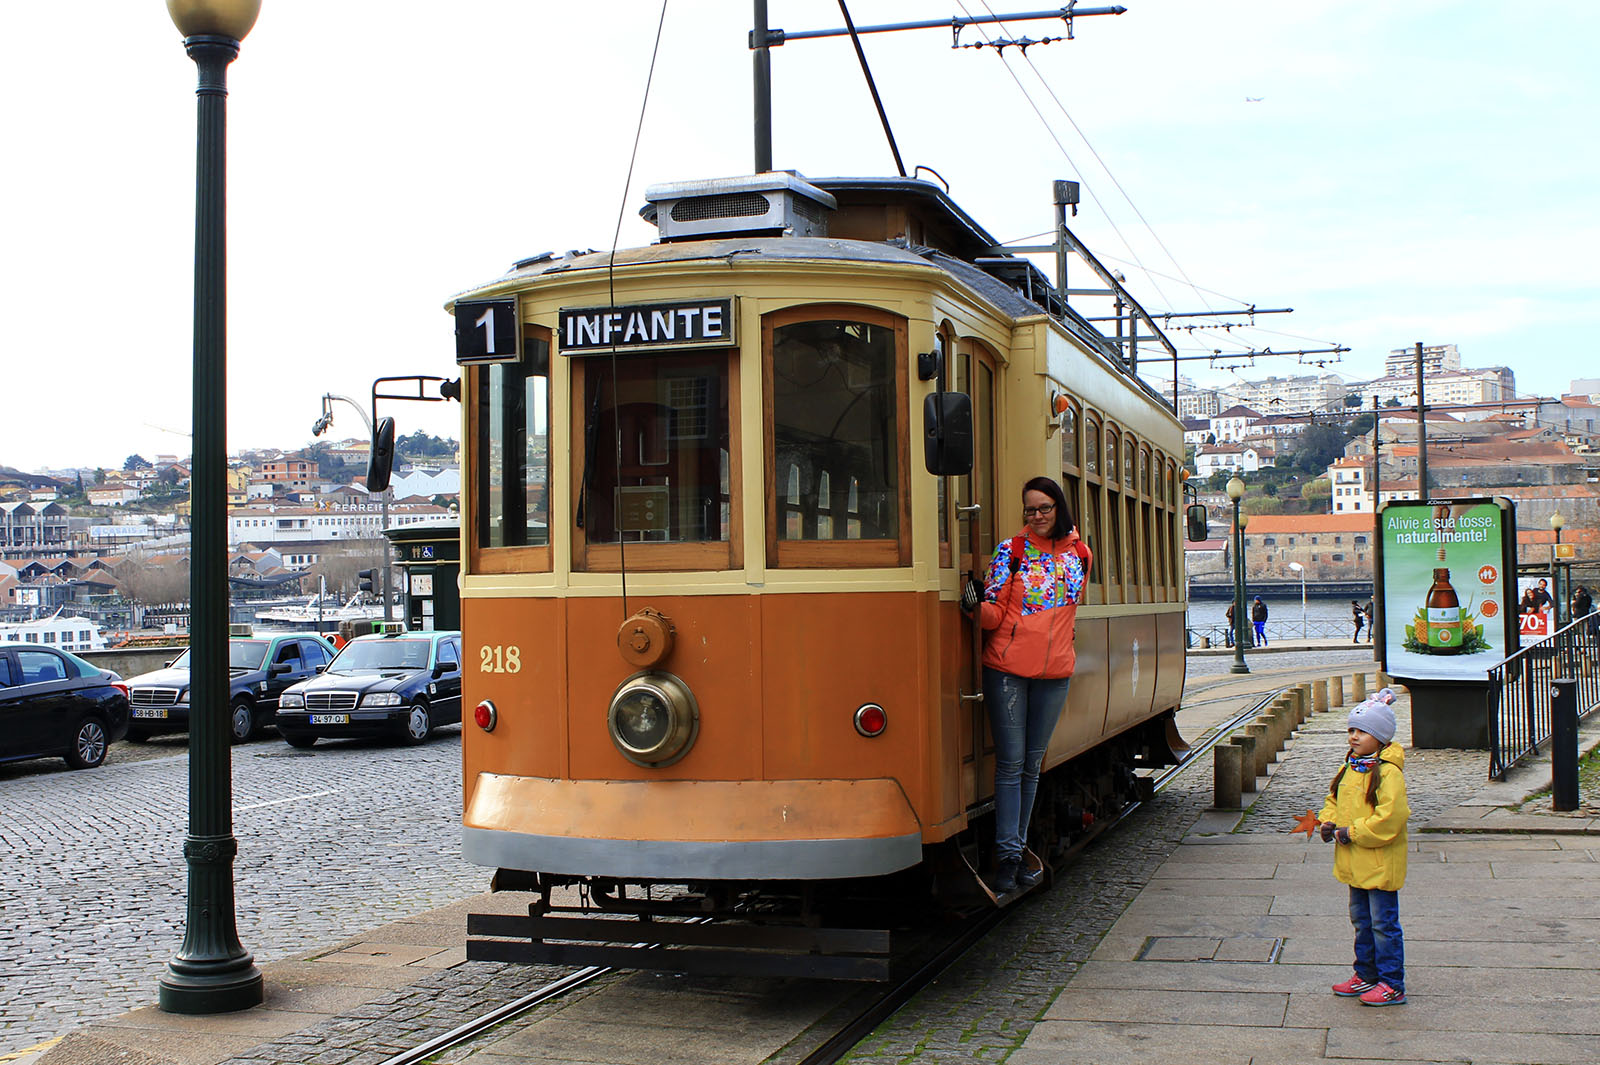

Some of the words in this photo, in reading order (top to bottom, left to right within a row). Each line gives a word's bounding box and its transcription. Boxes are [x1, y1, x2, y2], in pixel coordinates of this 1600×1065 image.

[475, 307, 496, 353] 1
[566, 306, 723, 346] INFANTE
[1388, 517, 1419, 530] Alivie
[1423, 520, 1431, 529] a
[1433, 518, 1456, 530] sua
[1459, 516, 1496, 529] tosse,
[1396, 529, 1488, 544] naturalmente!
[480, 645, 521, 673] 218
